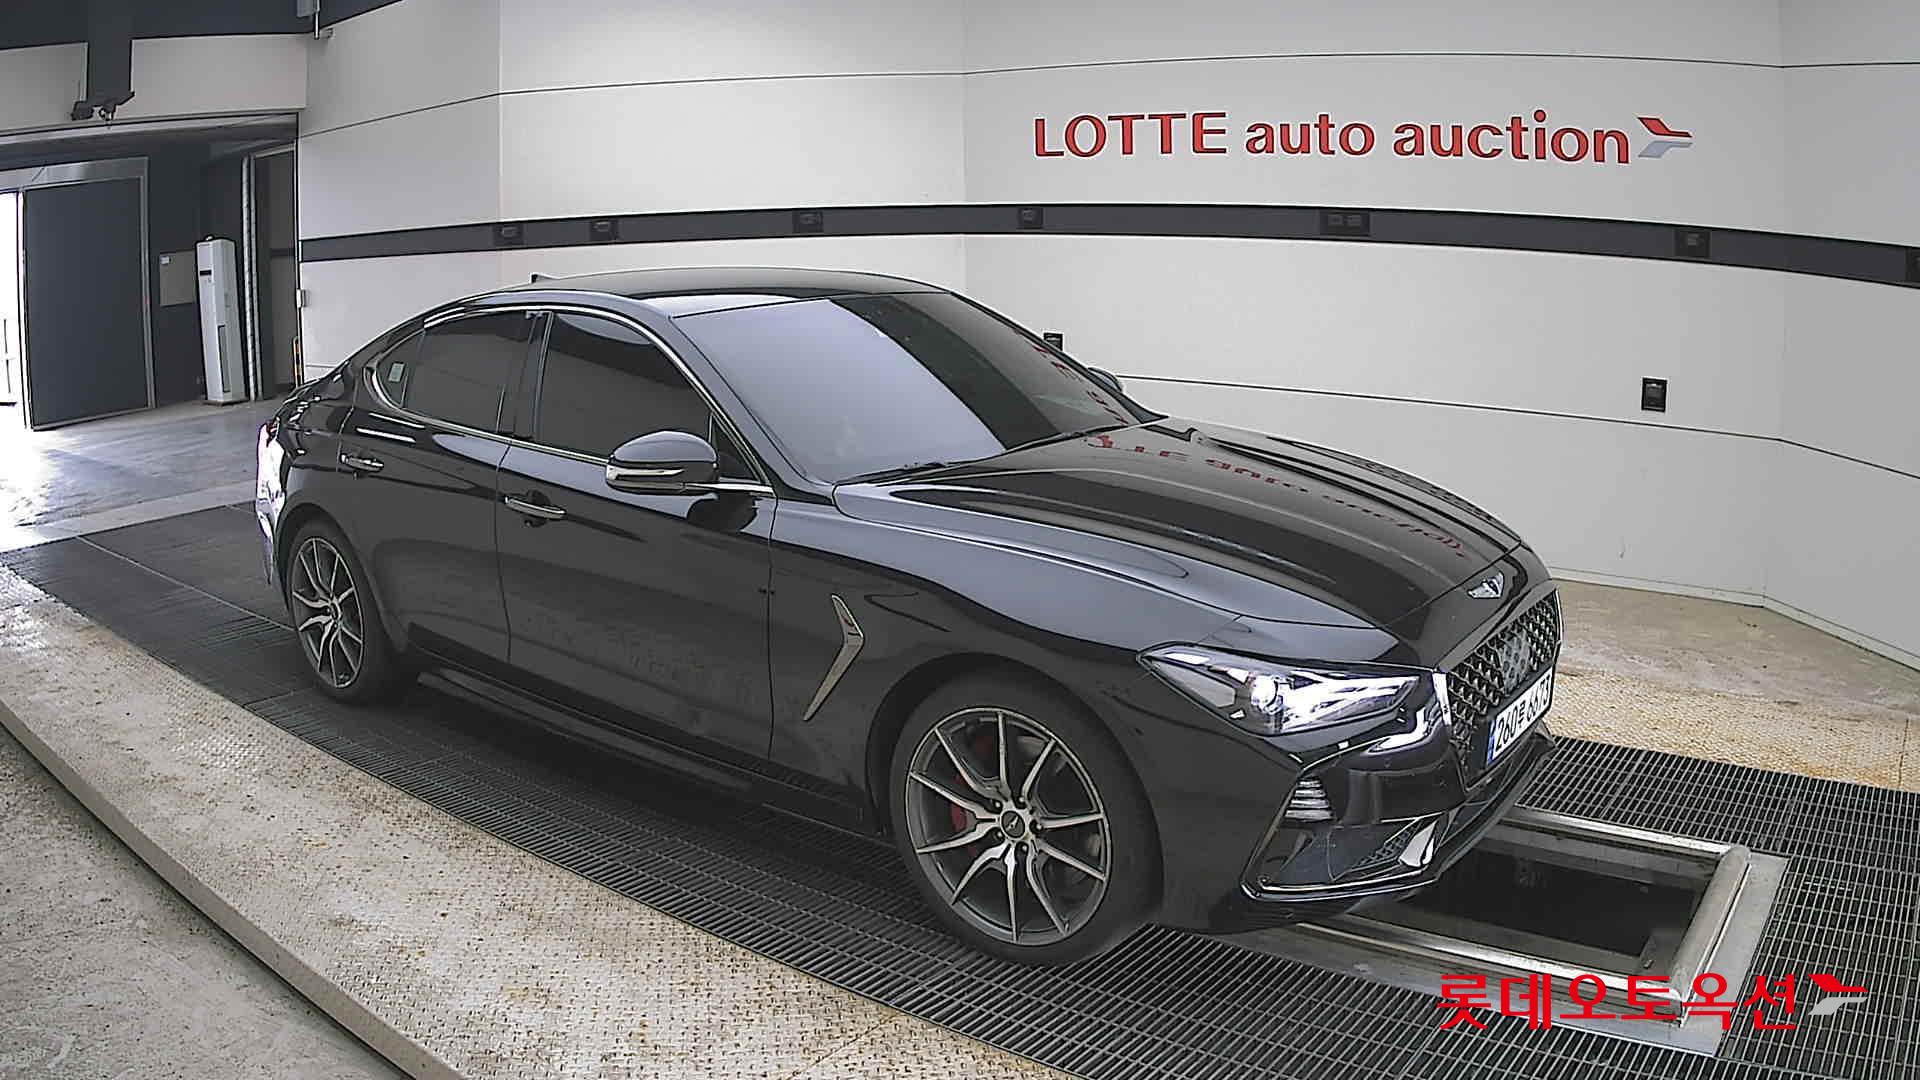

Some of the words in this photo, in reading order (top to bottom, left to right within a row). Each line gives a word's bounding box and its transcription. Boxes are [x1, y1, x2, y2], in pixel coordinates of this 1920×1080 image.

[1033, 111, 1228, 158] LOTTE
[1245, 113, 1376, 157] auto
[1392, 108, 1631, 165] auction
